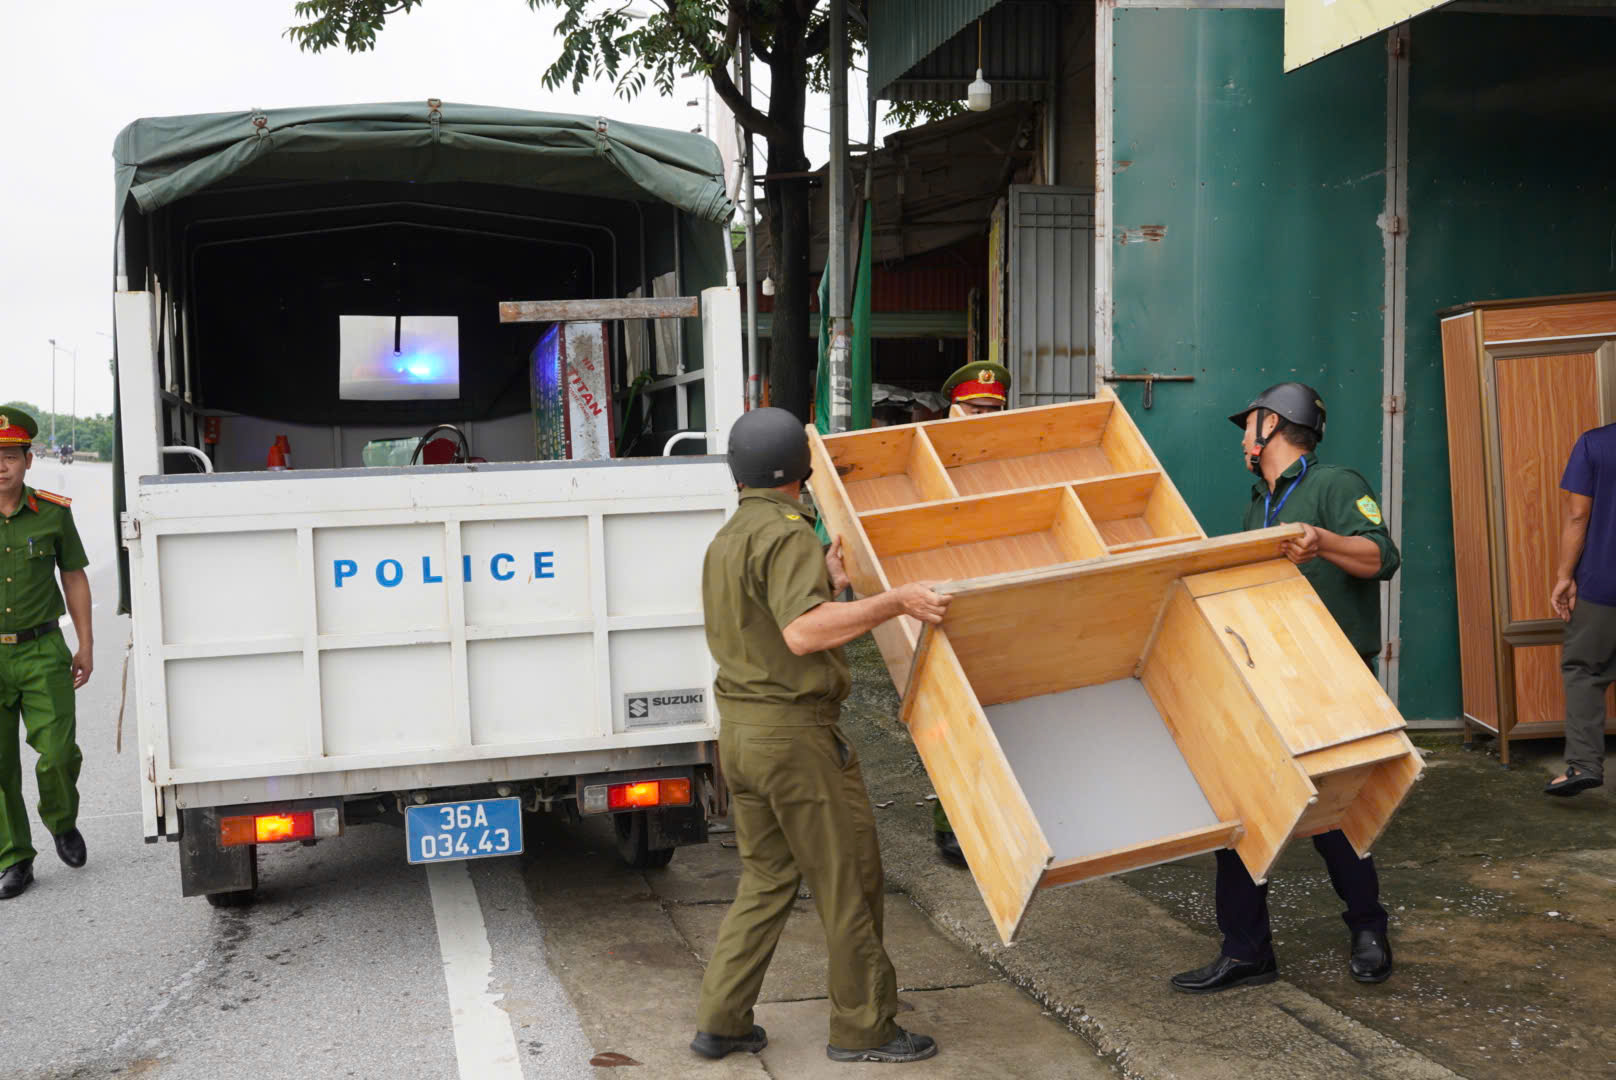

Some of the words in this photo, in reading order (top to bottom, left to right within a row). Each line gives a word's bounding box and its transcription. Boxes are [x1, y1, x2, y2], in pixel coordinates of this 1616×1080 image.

[567, 364, 603, 416] TITAN
[333, 551, 555, 588] POLICE
[652, 694, 703, 706] SUZUKI
[439, 803, 488, 830] 36A
[421, 828, 510, 859] 034.43
